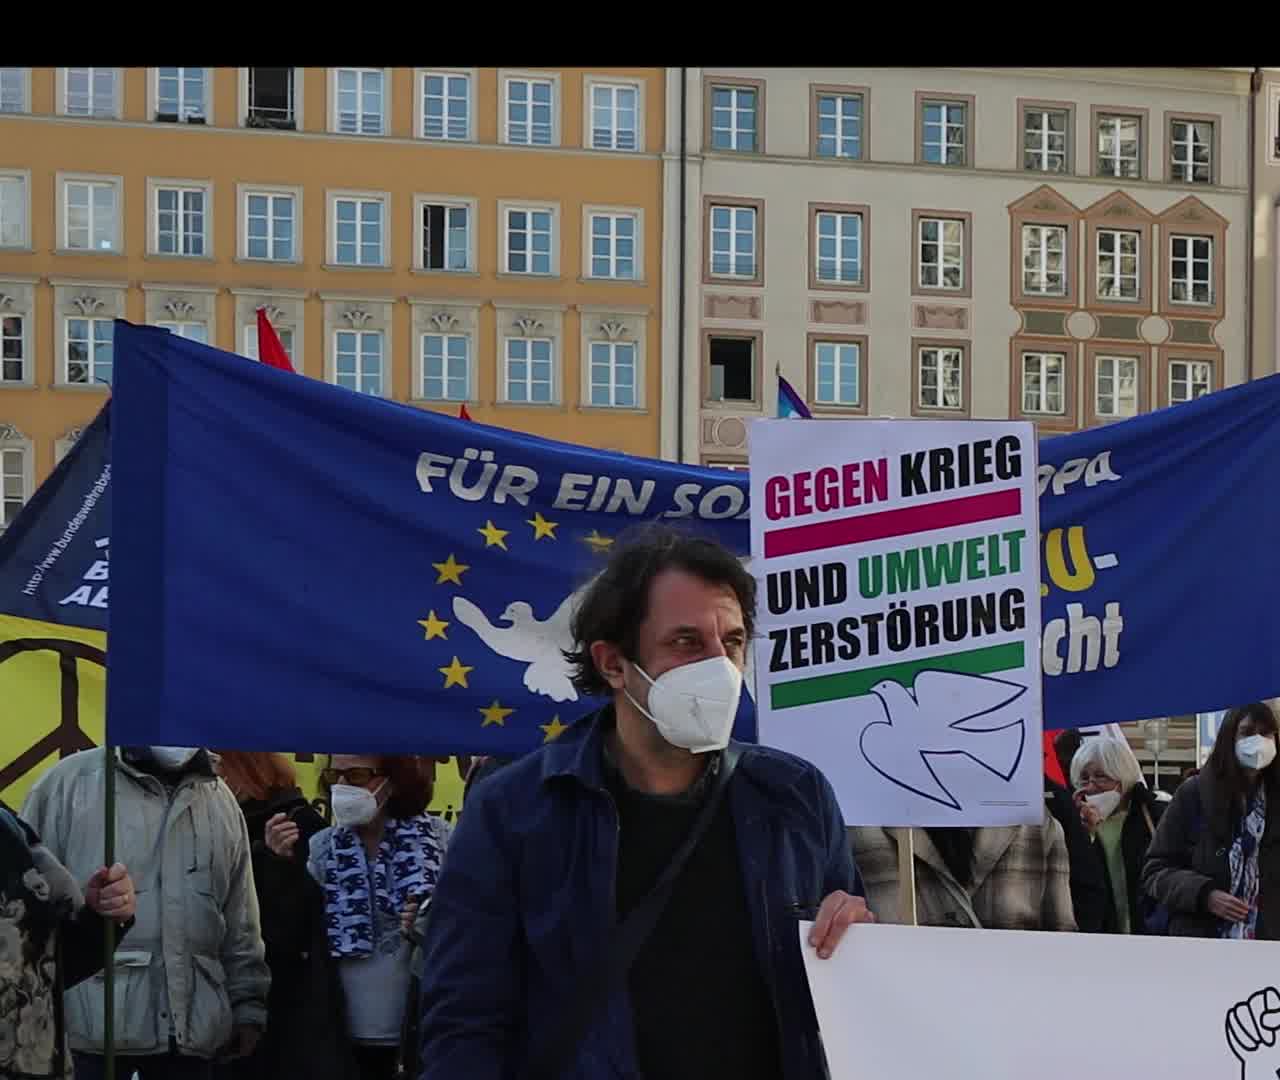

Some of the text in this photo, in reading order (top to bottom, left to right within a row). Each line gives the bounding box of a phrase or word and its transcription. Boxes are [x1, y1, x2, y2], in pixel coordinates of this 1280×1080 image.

[415, 447, 750, 520] FÜR EIN SO
[764, 435, 1021, 521] GEGEN KRIEG
[766, 529, 1026, 615] UND UMWELT
[768, 587, 1026, 673] ZERSTÖRUNG
